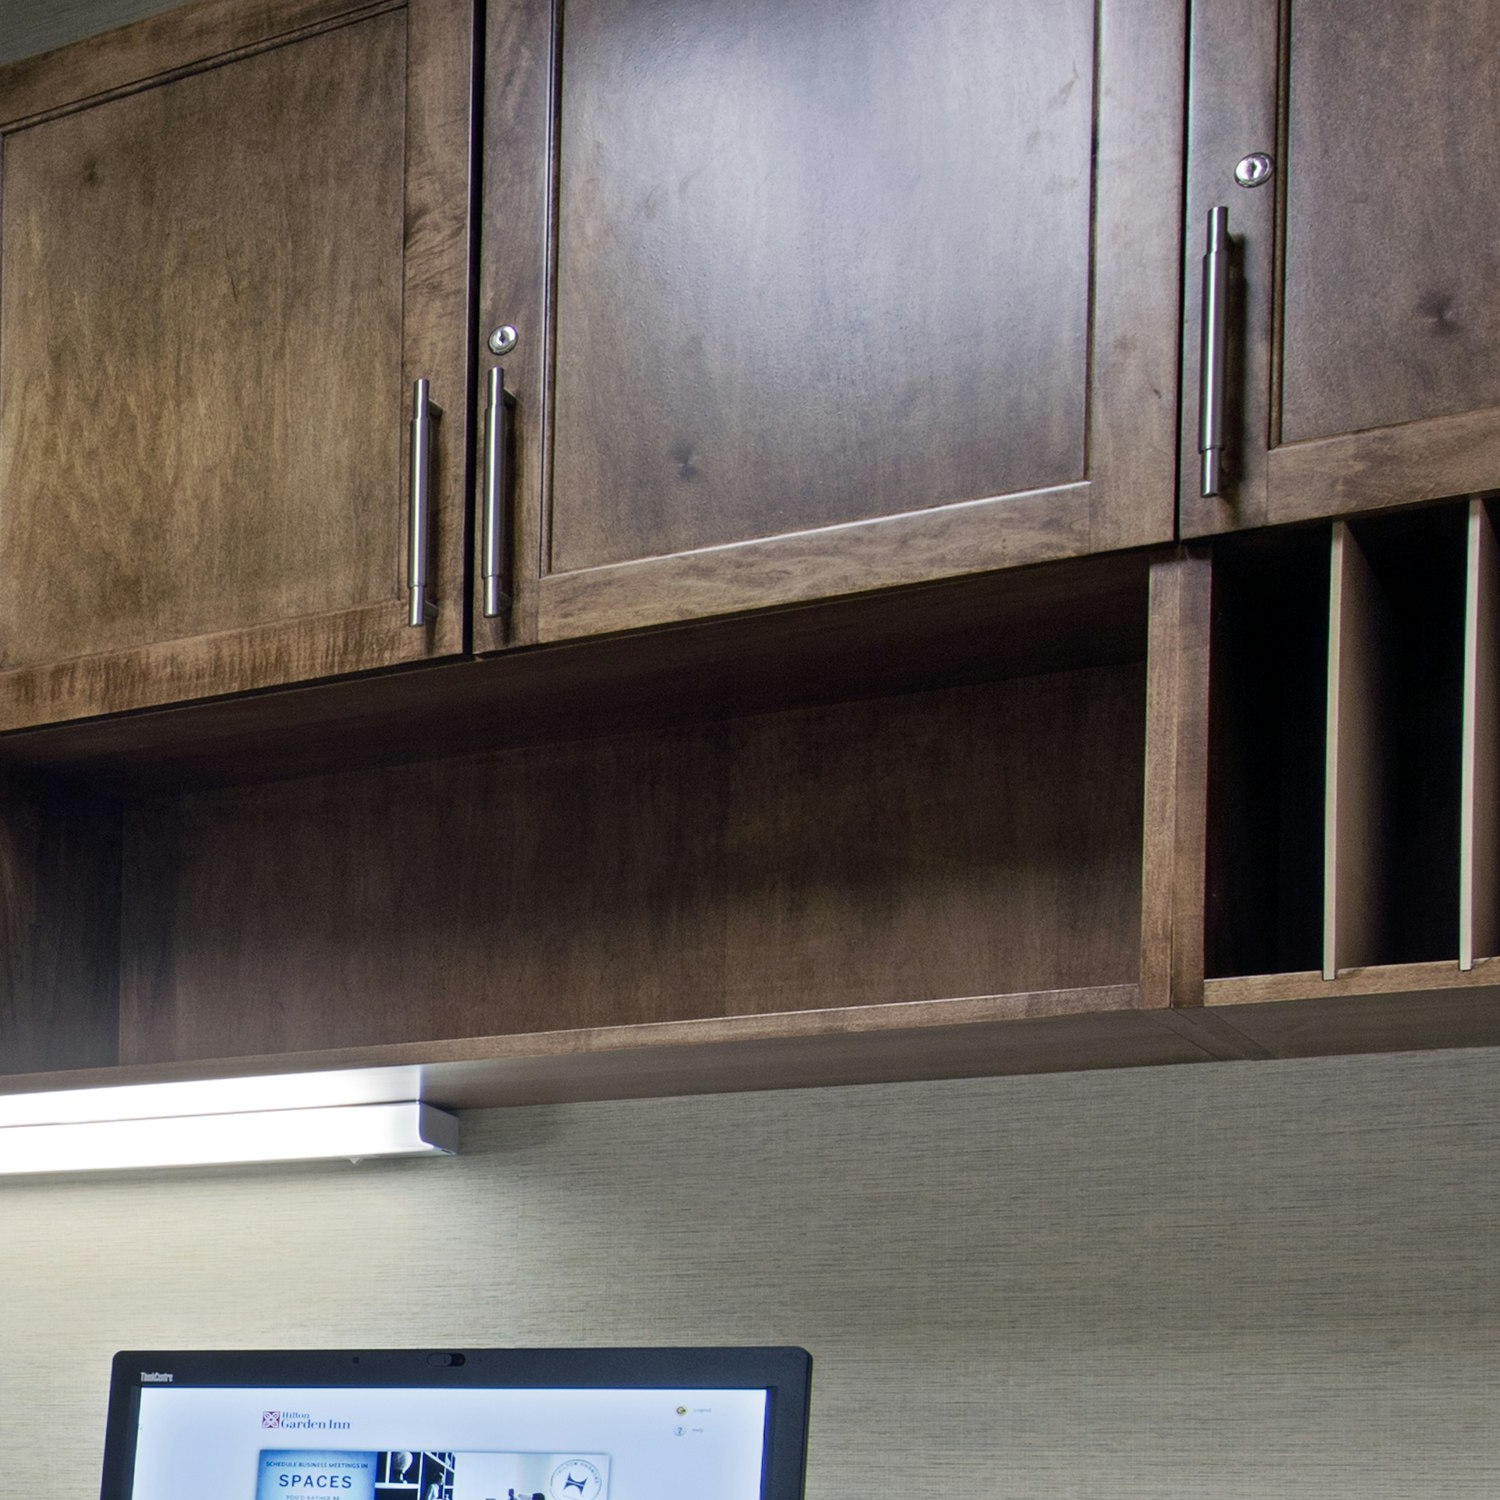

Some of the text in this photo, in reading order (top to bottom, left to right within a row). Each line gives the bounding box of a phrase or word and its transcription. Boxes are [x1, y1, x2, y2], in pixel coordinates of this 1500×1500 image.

[281, 1419, 350, 1429] Garden Inn
[279, 1474, 352, 1489] SPACES
